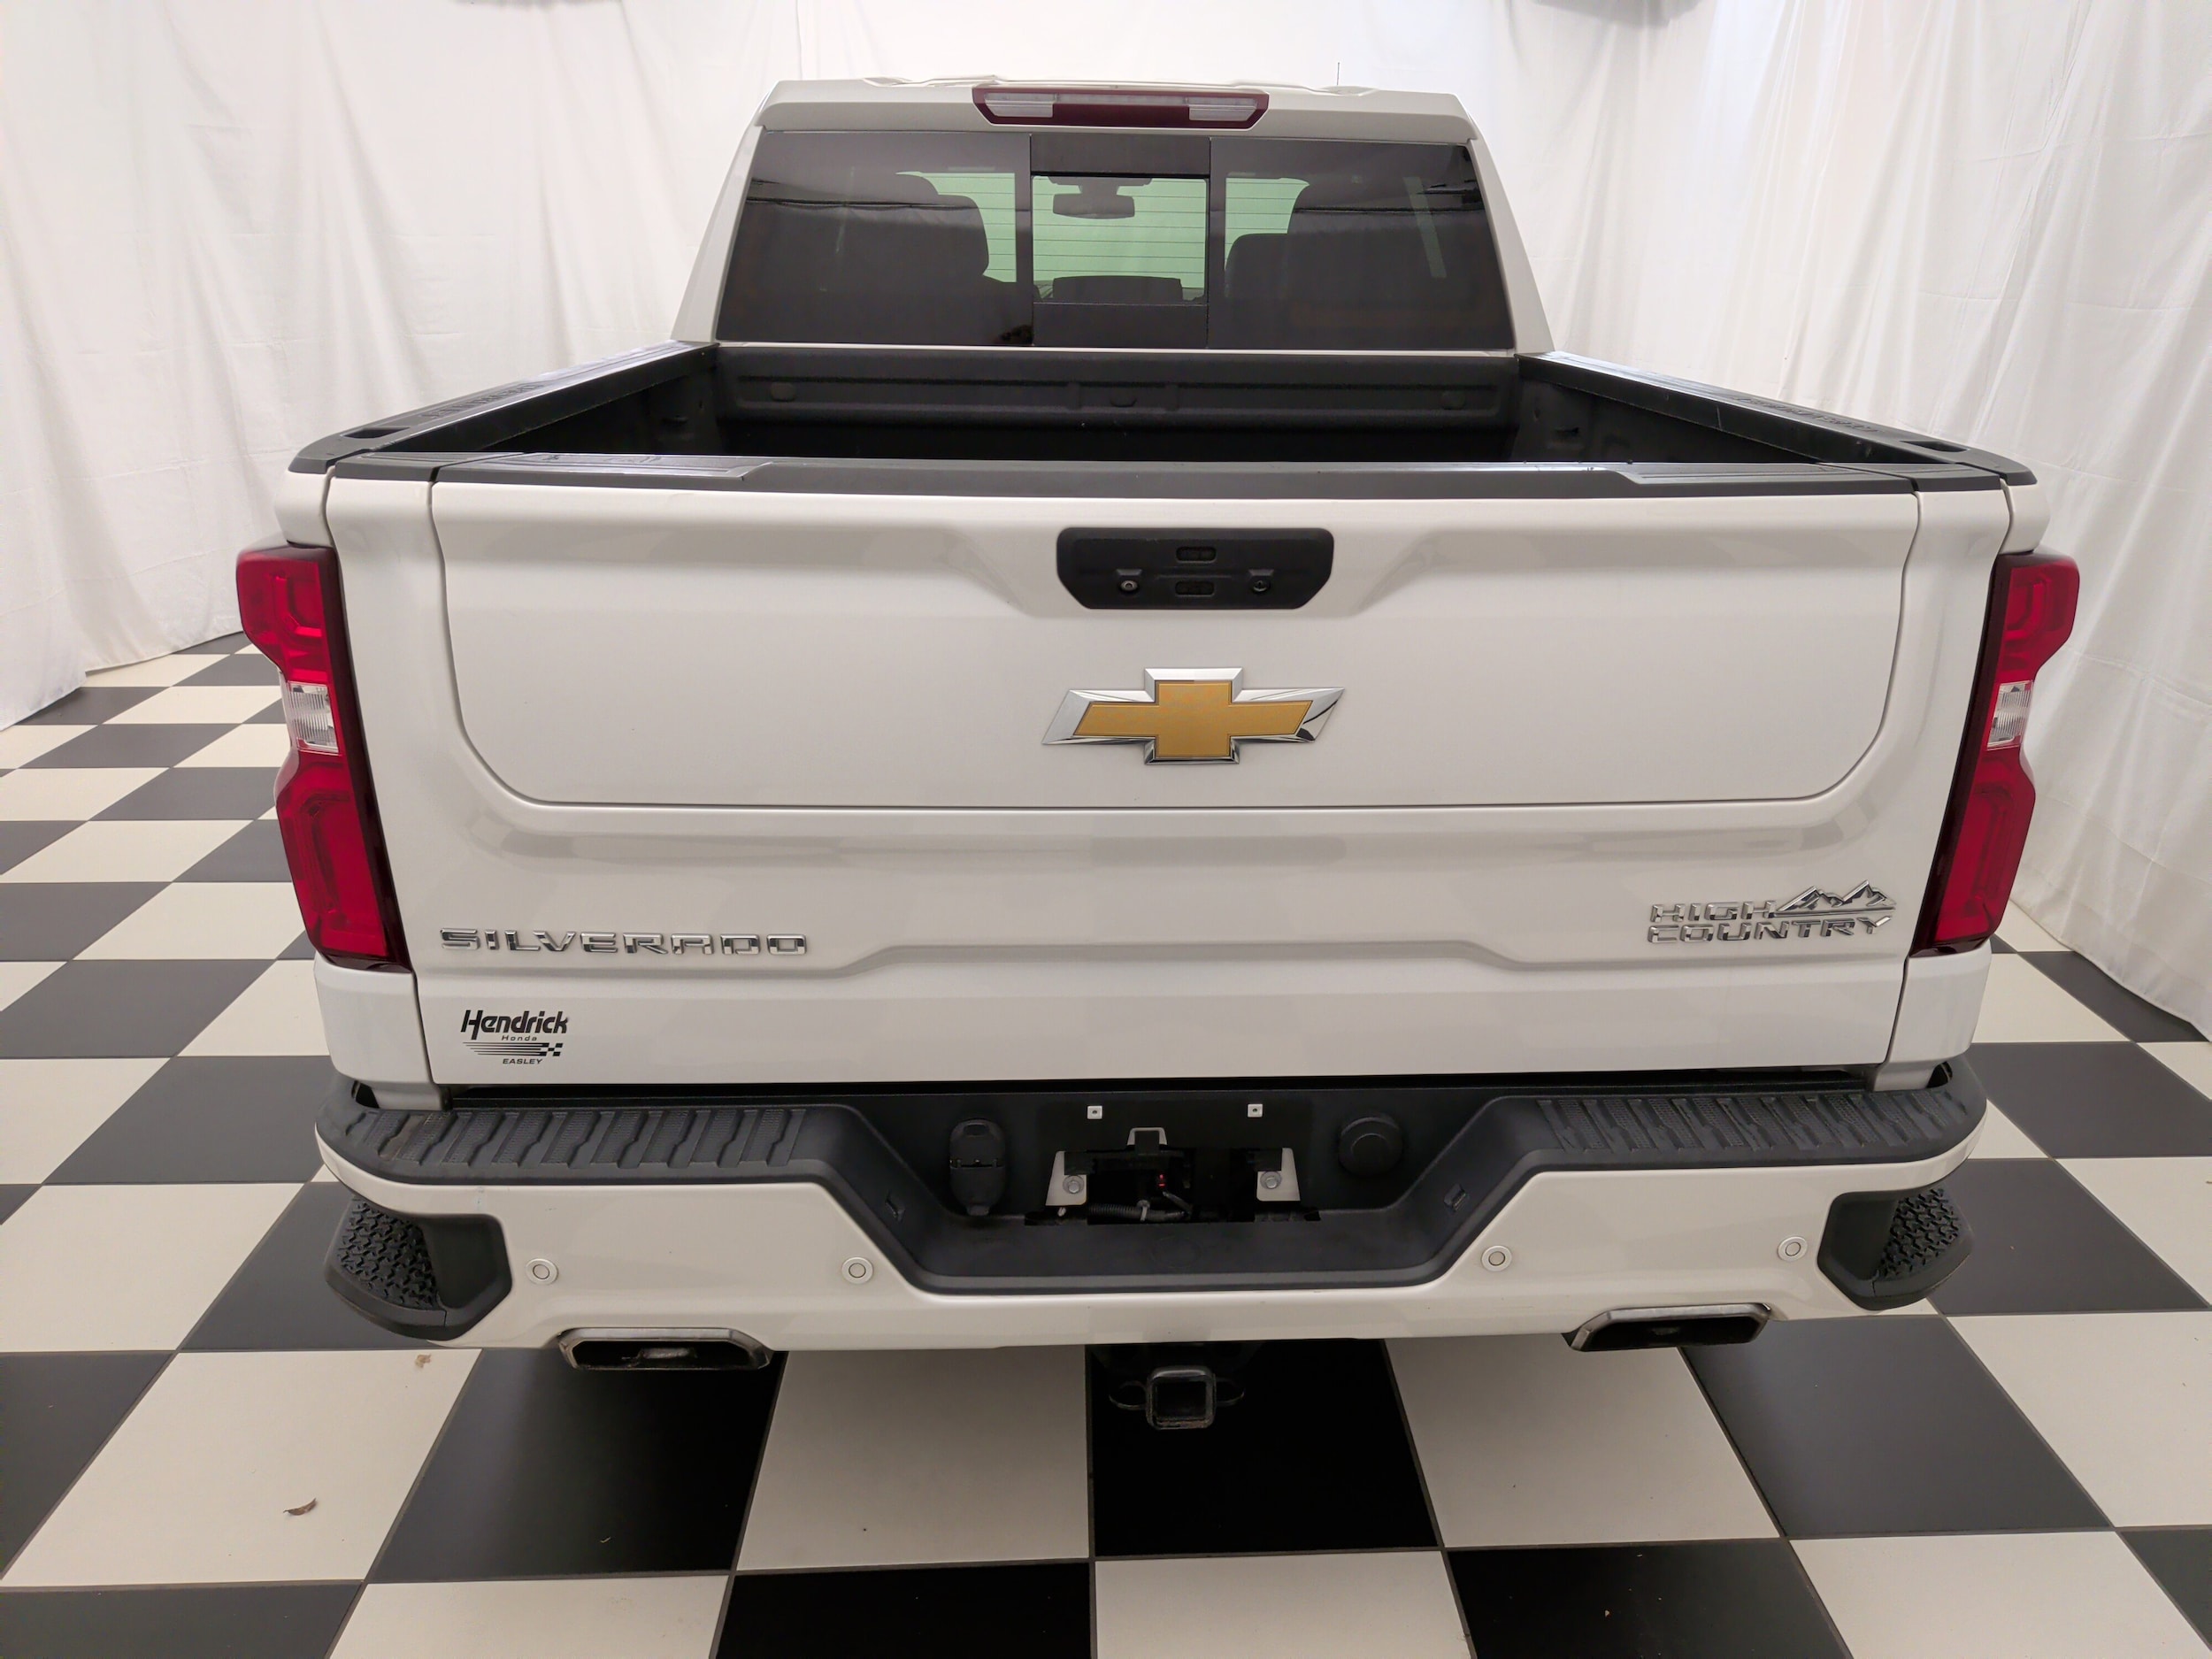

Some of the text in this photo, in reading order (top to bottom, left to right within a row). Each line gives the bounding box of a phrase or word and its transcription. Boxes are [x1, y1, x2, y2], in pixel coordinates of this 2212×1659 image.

[1650, 900, 1777, 923] HIGH
[441, 927, 807, 956] SILVERADO
[1647, 915, 1893, 943] COUNTRY
[460, 1010, 568, 1041] Hendrick
